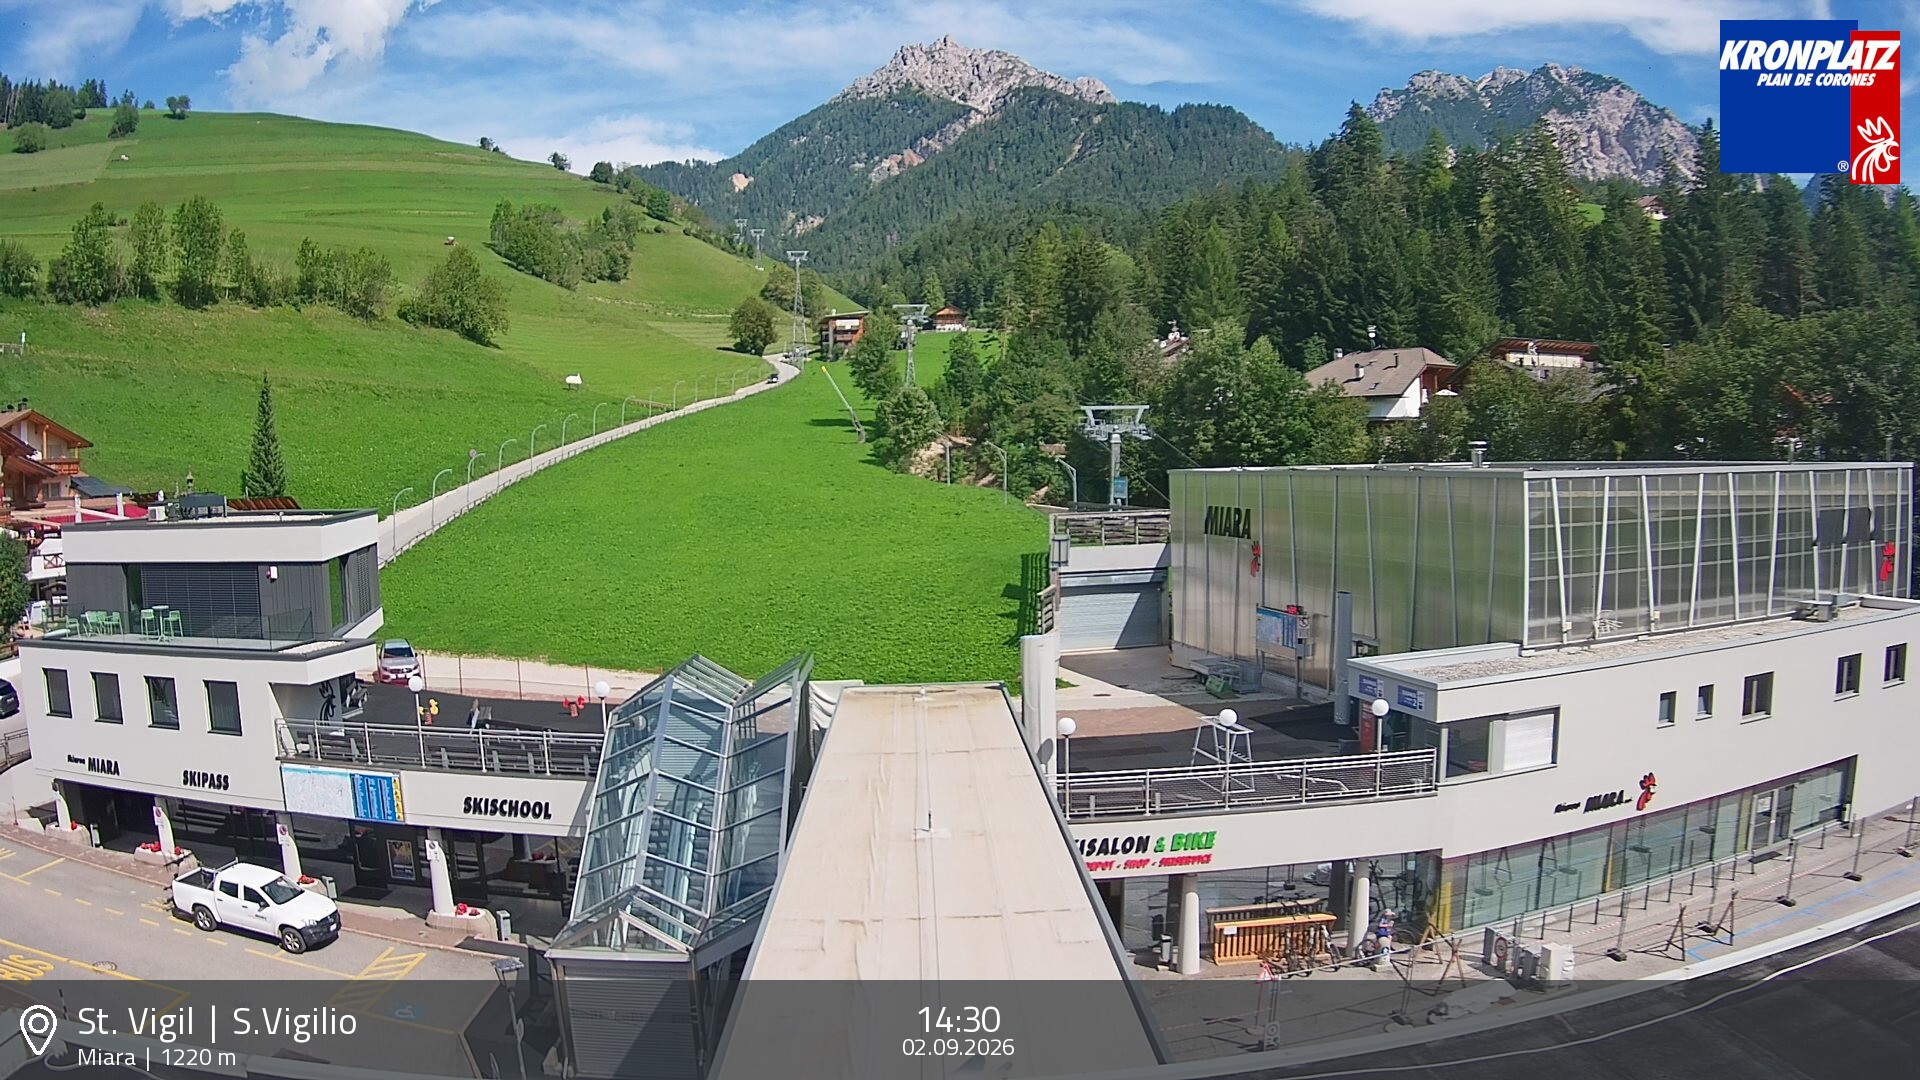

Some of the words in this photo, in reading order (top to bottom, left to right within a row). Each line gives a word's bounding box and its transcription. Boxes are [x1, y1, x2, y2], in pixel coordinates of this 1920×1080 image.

[1204, 506, 1251, 539] MIARA
[88, 756, 120, 776] MIARA
[182, 770, 229, 791] SKIPASS
[463, 796, 552, 819] SKISCHOOL
[1153, 836, 1165, 853] &
[1170, 831, 1217, 852] BIKE
